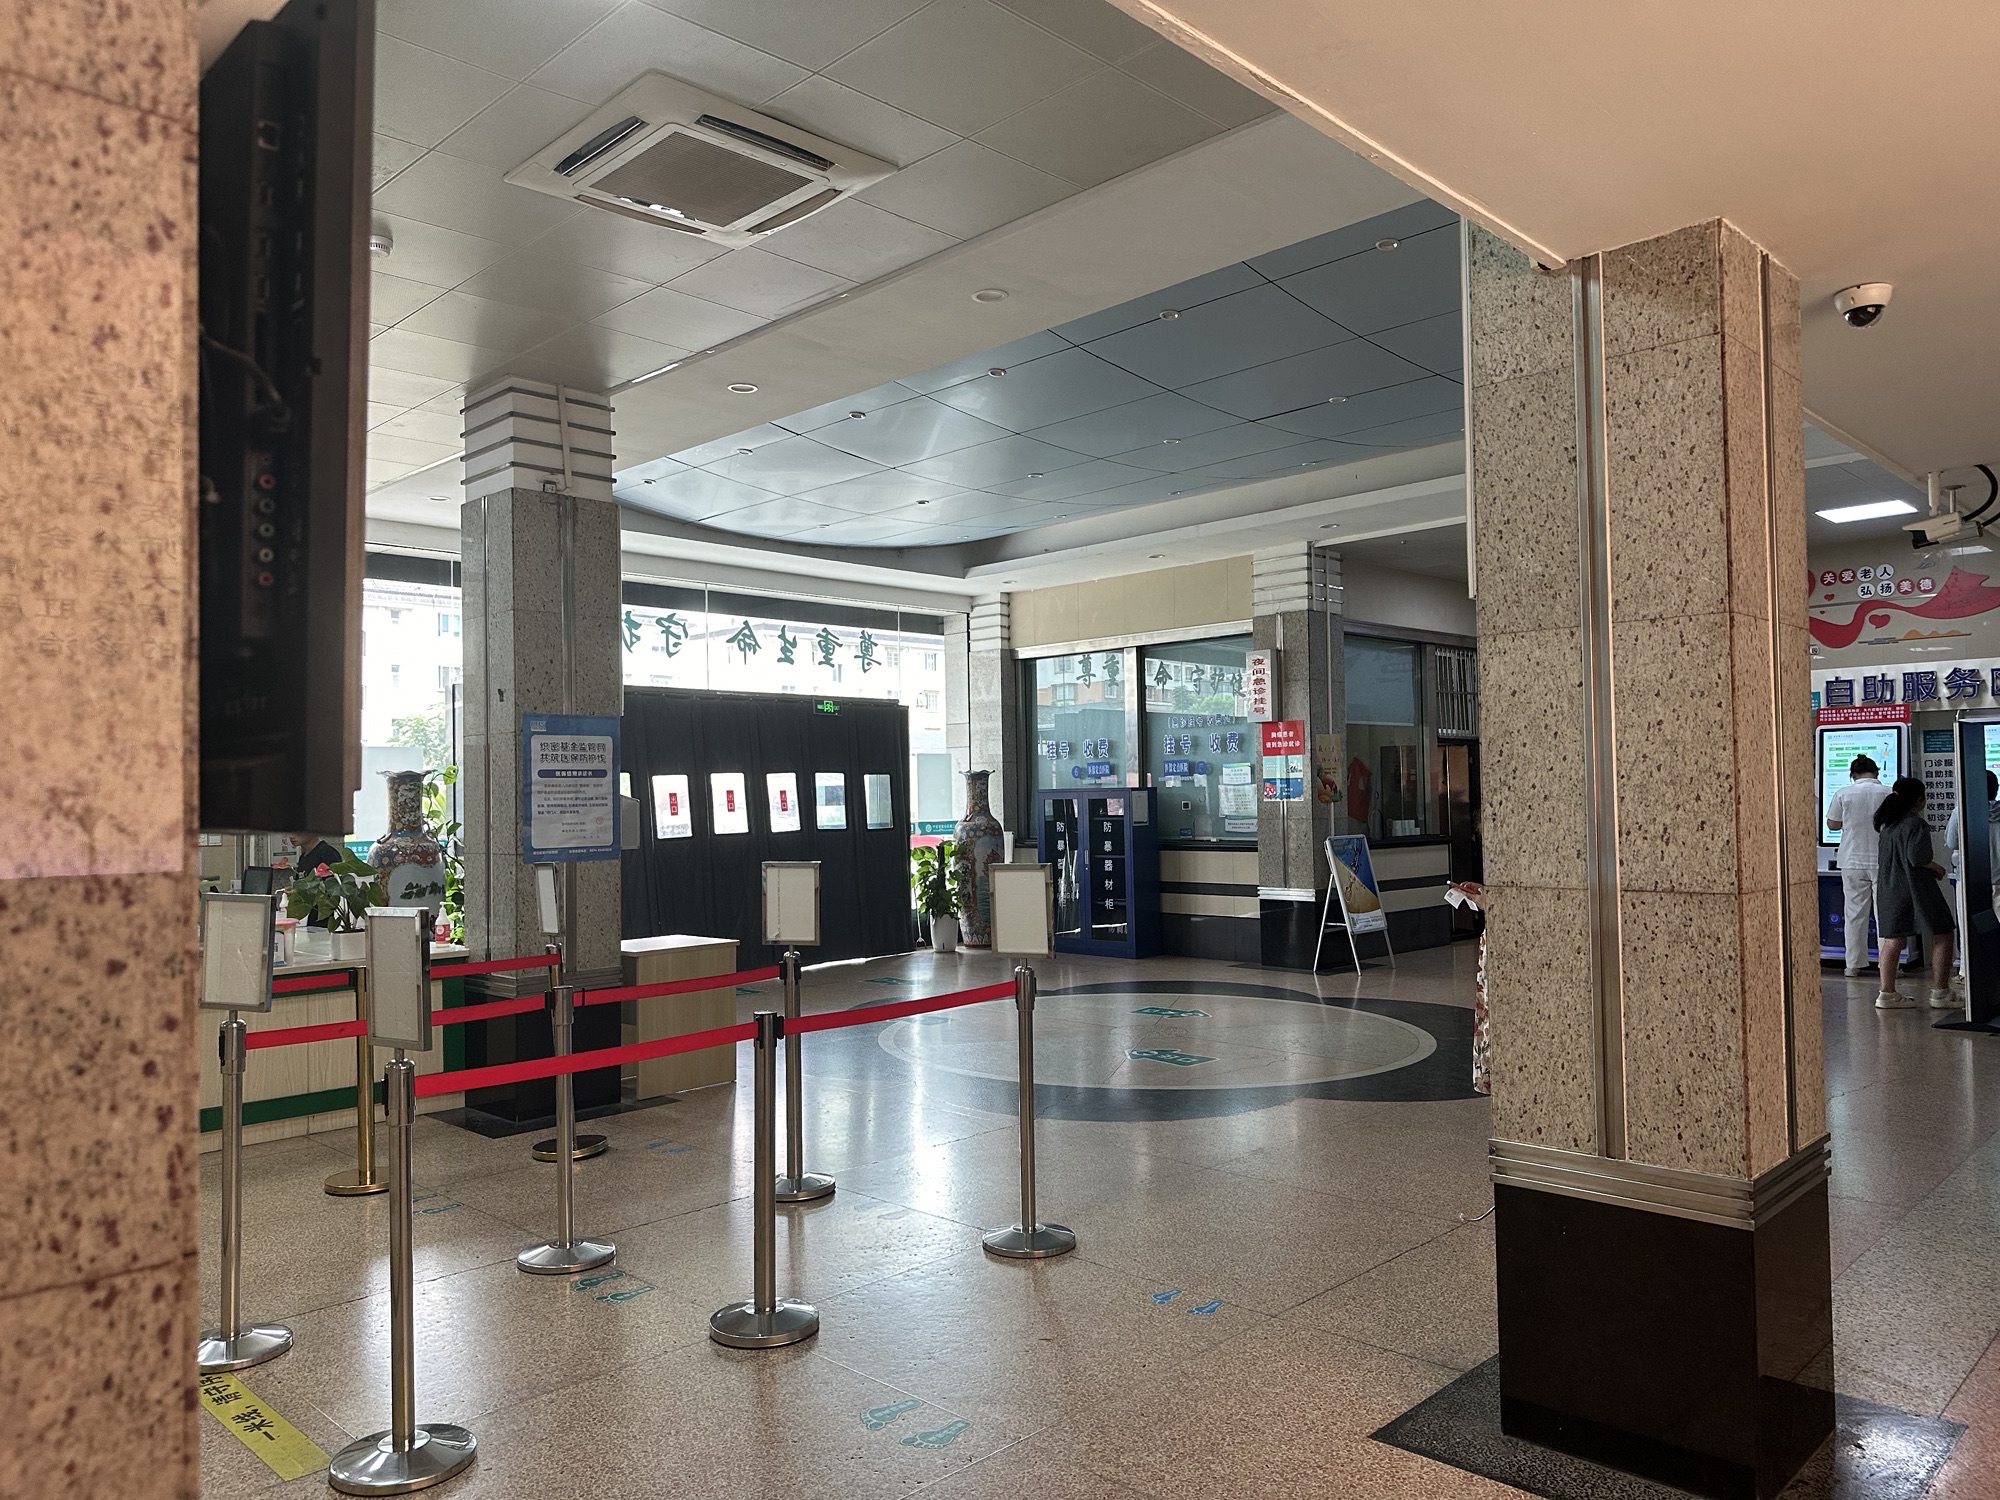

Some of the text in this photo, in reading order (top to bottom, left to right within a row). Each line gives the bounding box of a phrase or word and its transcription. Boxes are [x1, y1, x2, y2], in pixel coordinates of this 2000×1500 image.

[1822, 565, 1892, 585] 关爱老人
[1859, 578, 1933, 597] 弘扬美德
[1251, 657, 1267, 715] 夜间急诊挂号
[1046, 737, 1109, 759] 挂号 收费
[1163, 731, 1239, 755] 挂号 收费
[1103, 821, 1114, 910] 防暴器材柜
